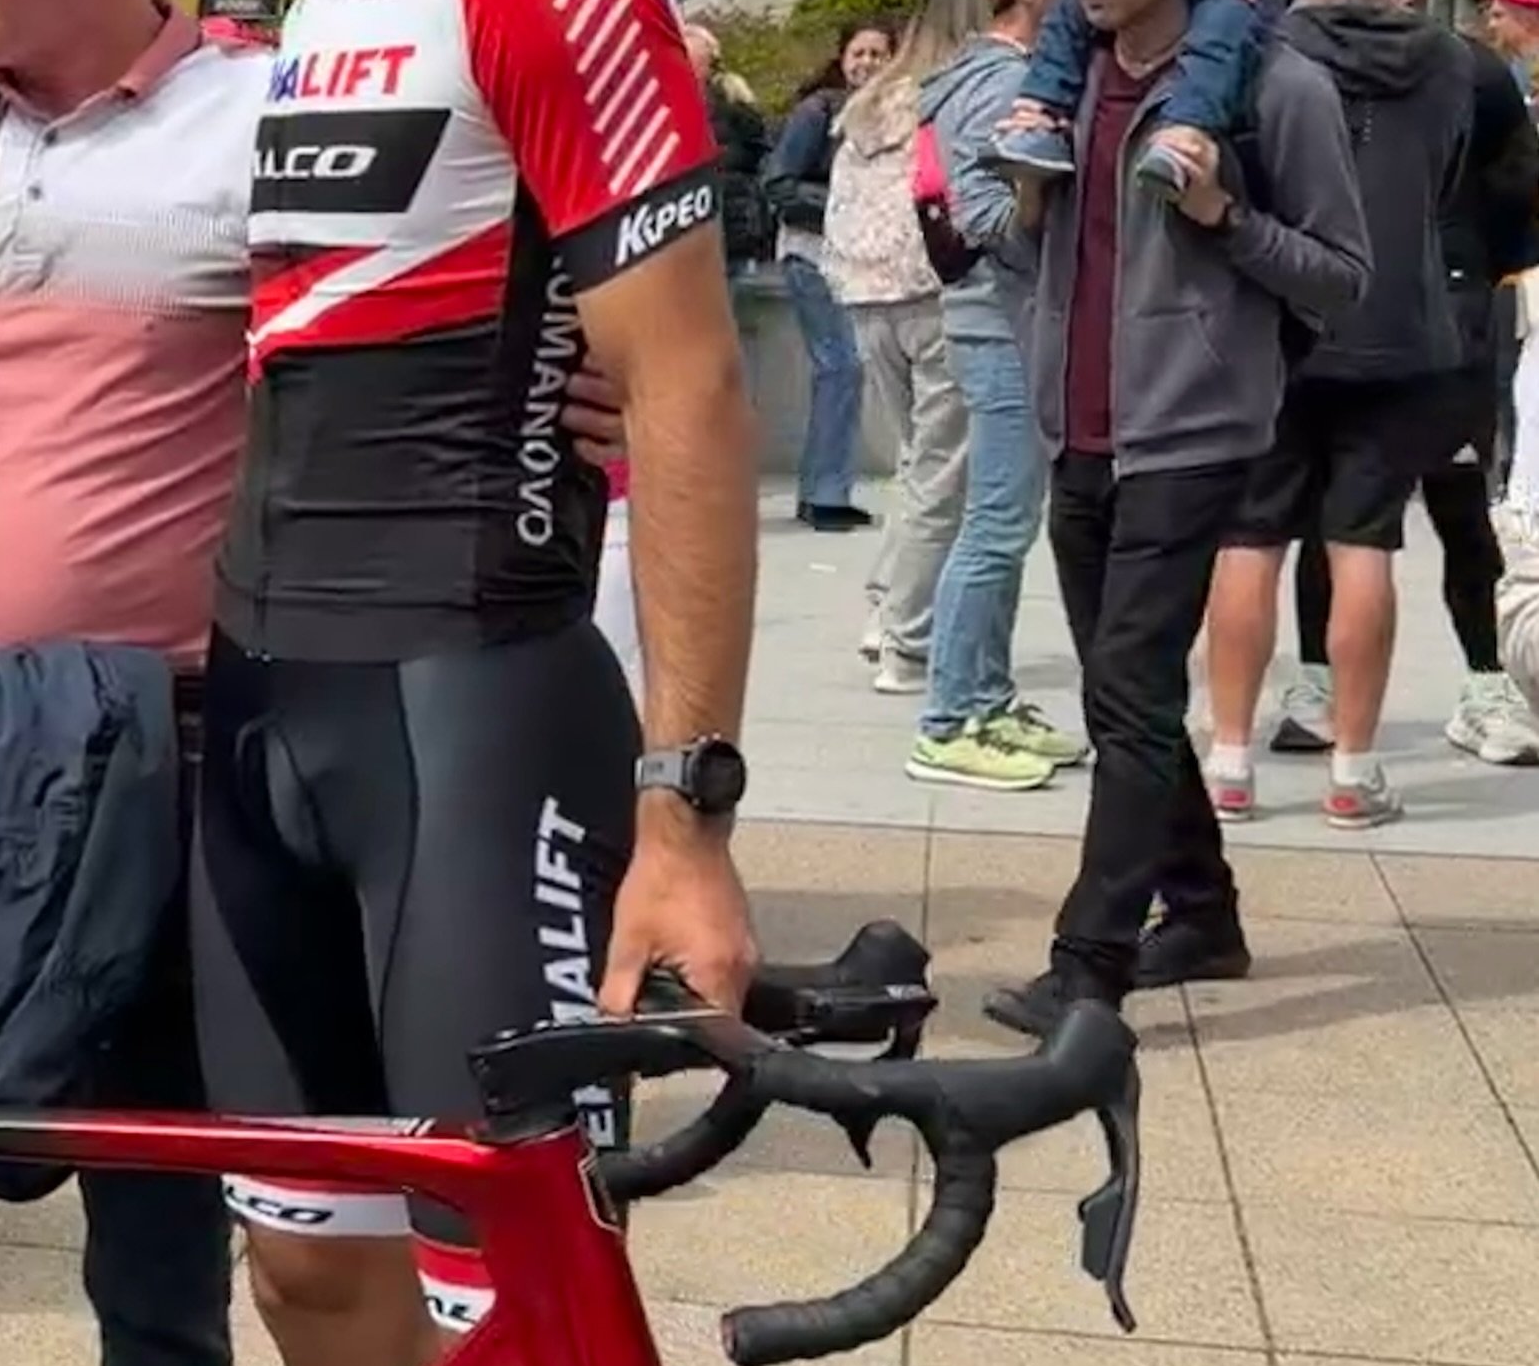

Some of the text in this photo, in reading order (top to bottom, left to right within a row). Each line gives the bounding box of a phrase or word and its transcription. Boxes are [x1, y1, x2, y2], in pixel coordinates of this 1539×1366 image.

[266, 45, 416, 102] ALIFT
[253, 144, 377, 182] LCO
[516, 255, 579, 547] UMANOVO
